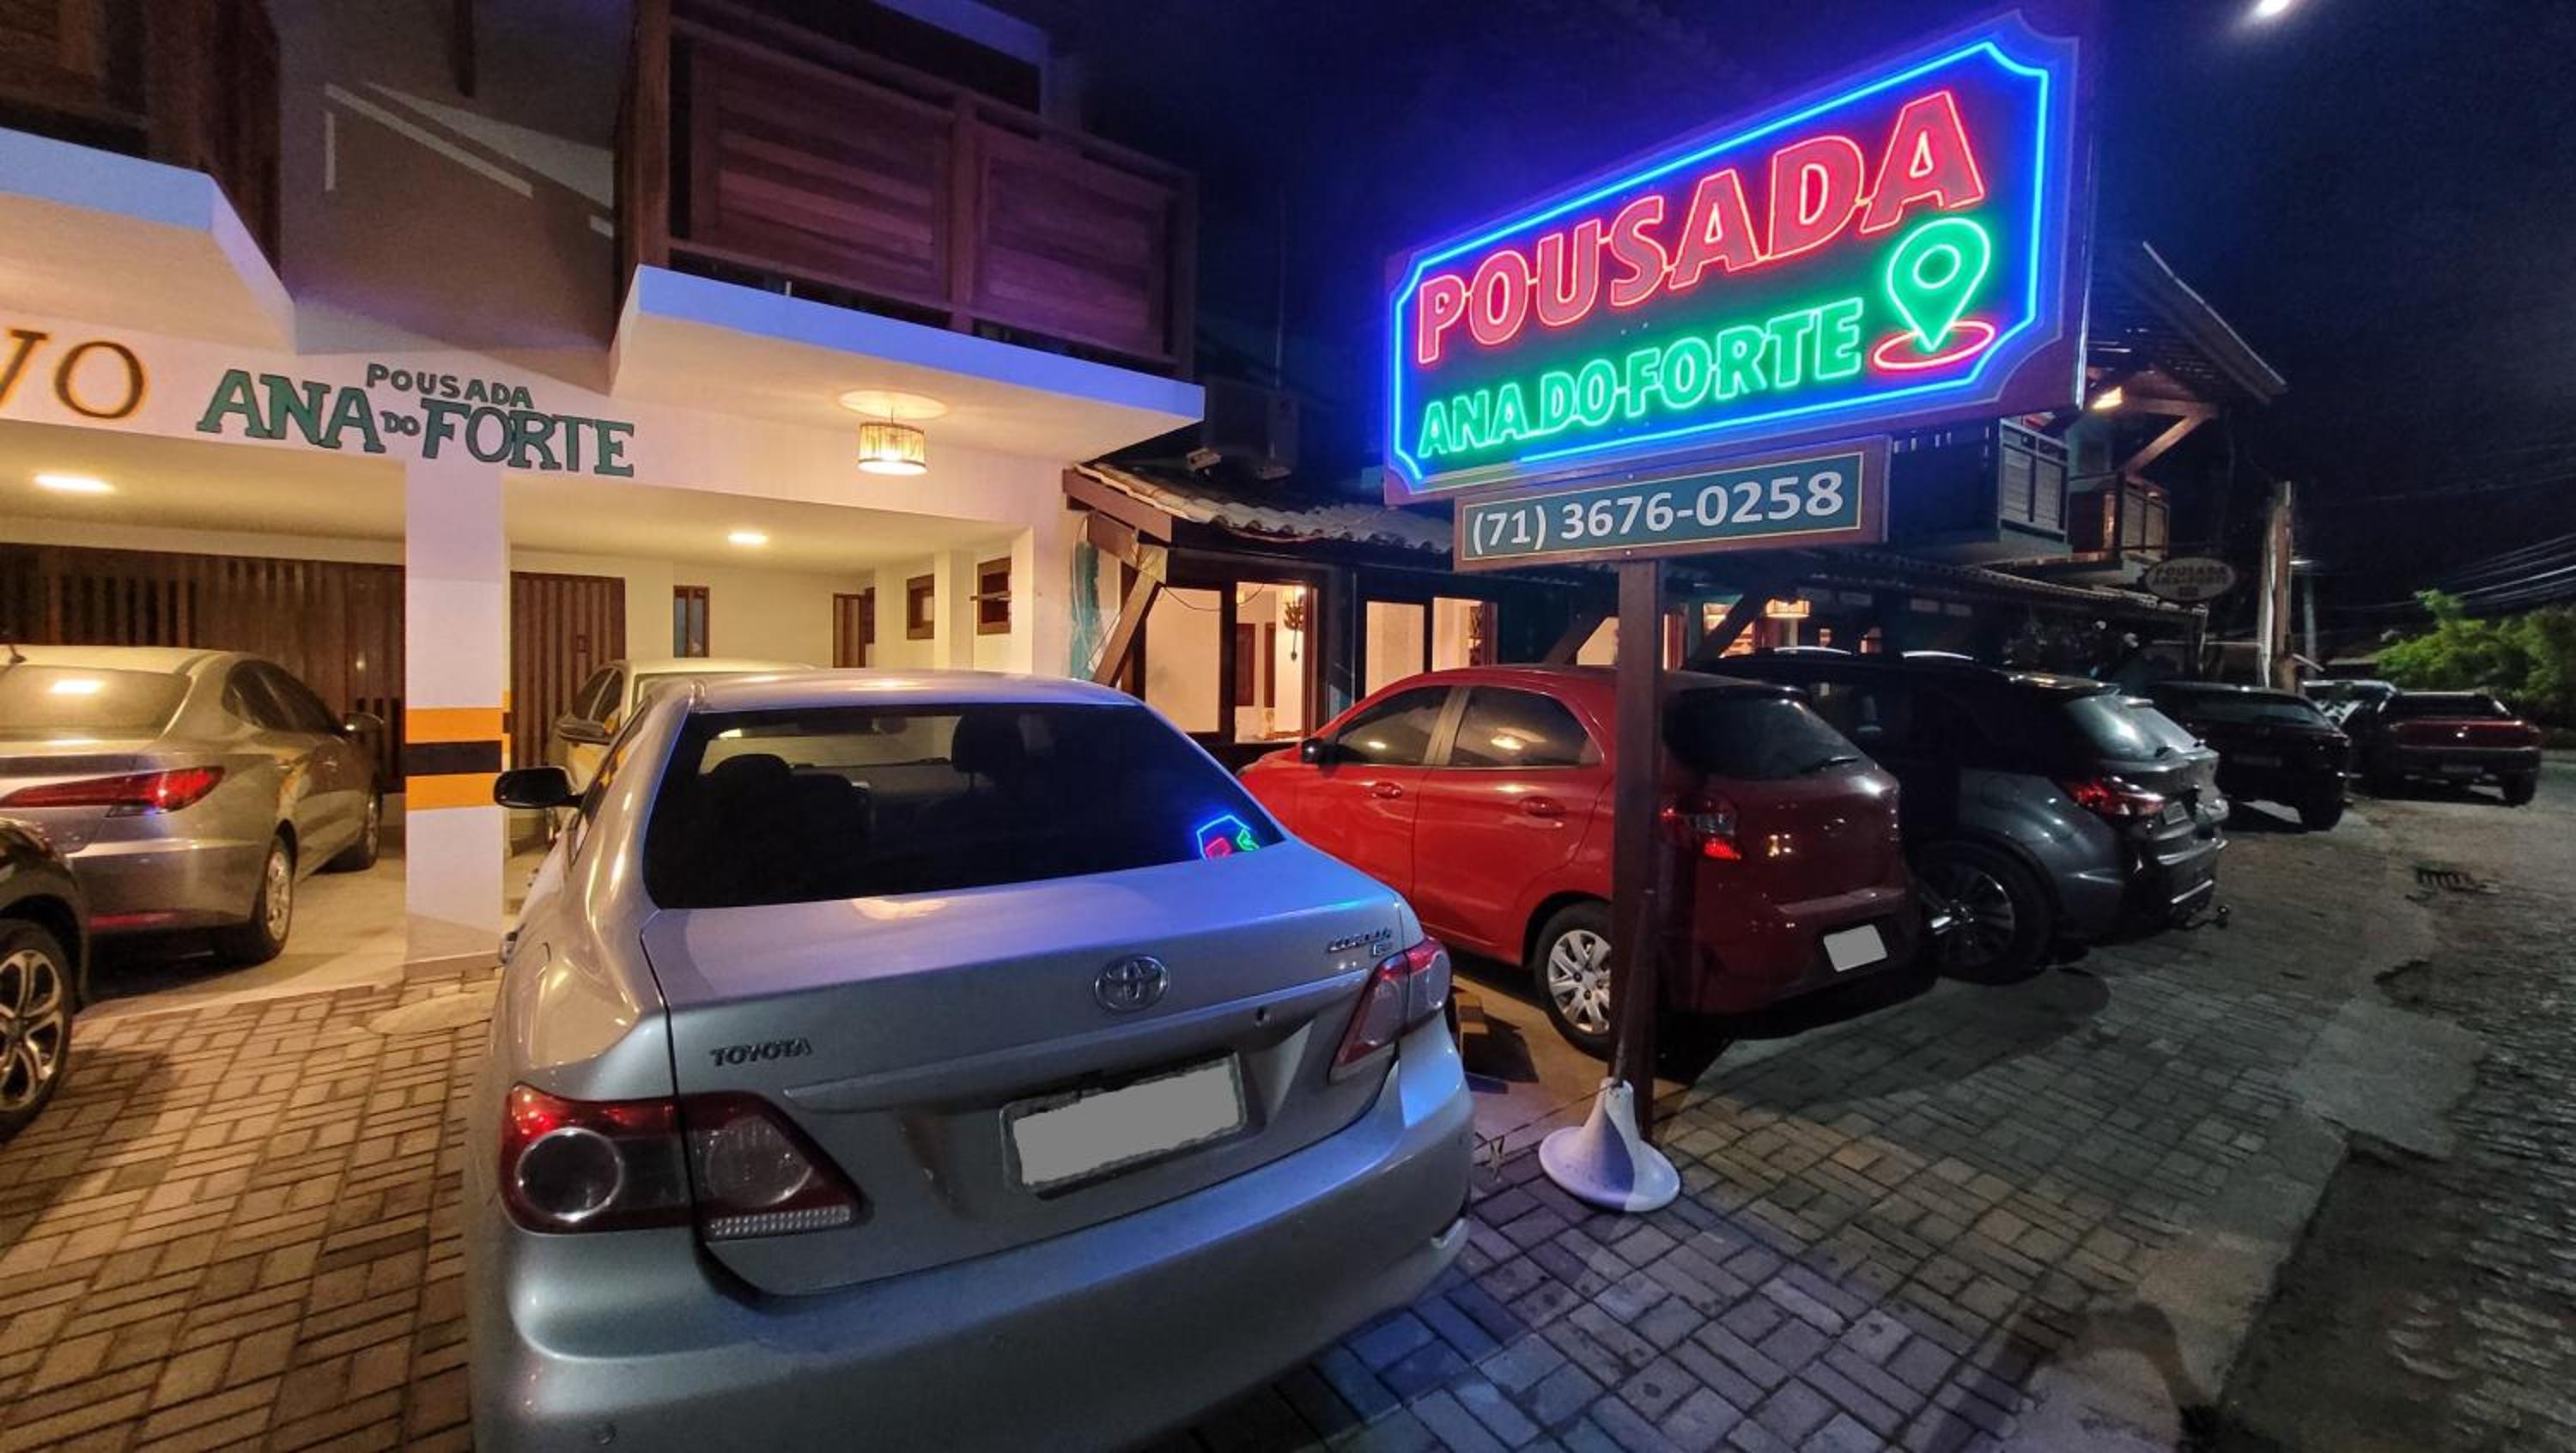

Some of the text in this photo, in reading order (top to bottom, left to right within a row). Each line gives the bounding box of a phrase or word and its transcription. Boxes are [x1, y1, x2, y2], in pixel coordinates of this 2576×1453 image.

[1418, 90, 1985, 364] POUSADA
[197, 368, 635, 477] ANA DO FORTE
[366, 363, 534, 409] POUSADA
[1418, 296, 1863, 458] ANA DO FORTE
[1473, 471, 1844, 555] (71) 3676-0258
[709, 1037, 813, 1067] TOYOTA
